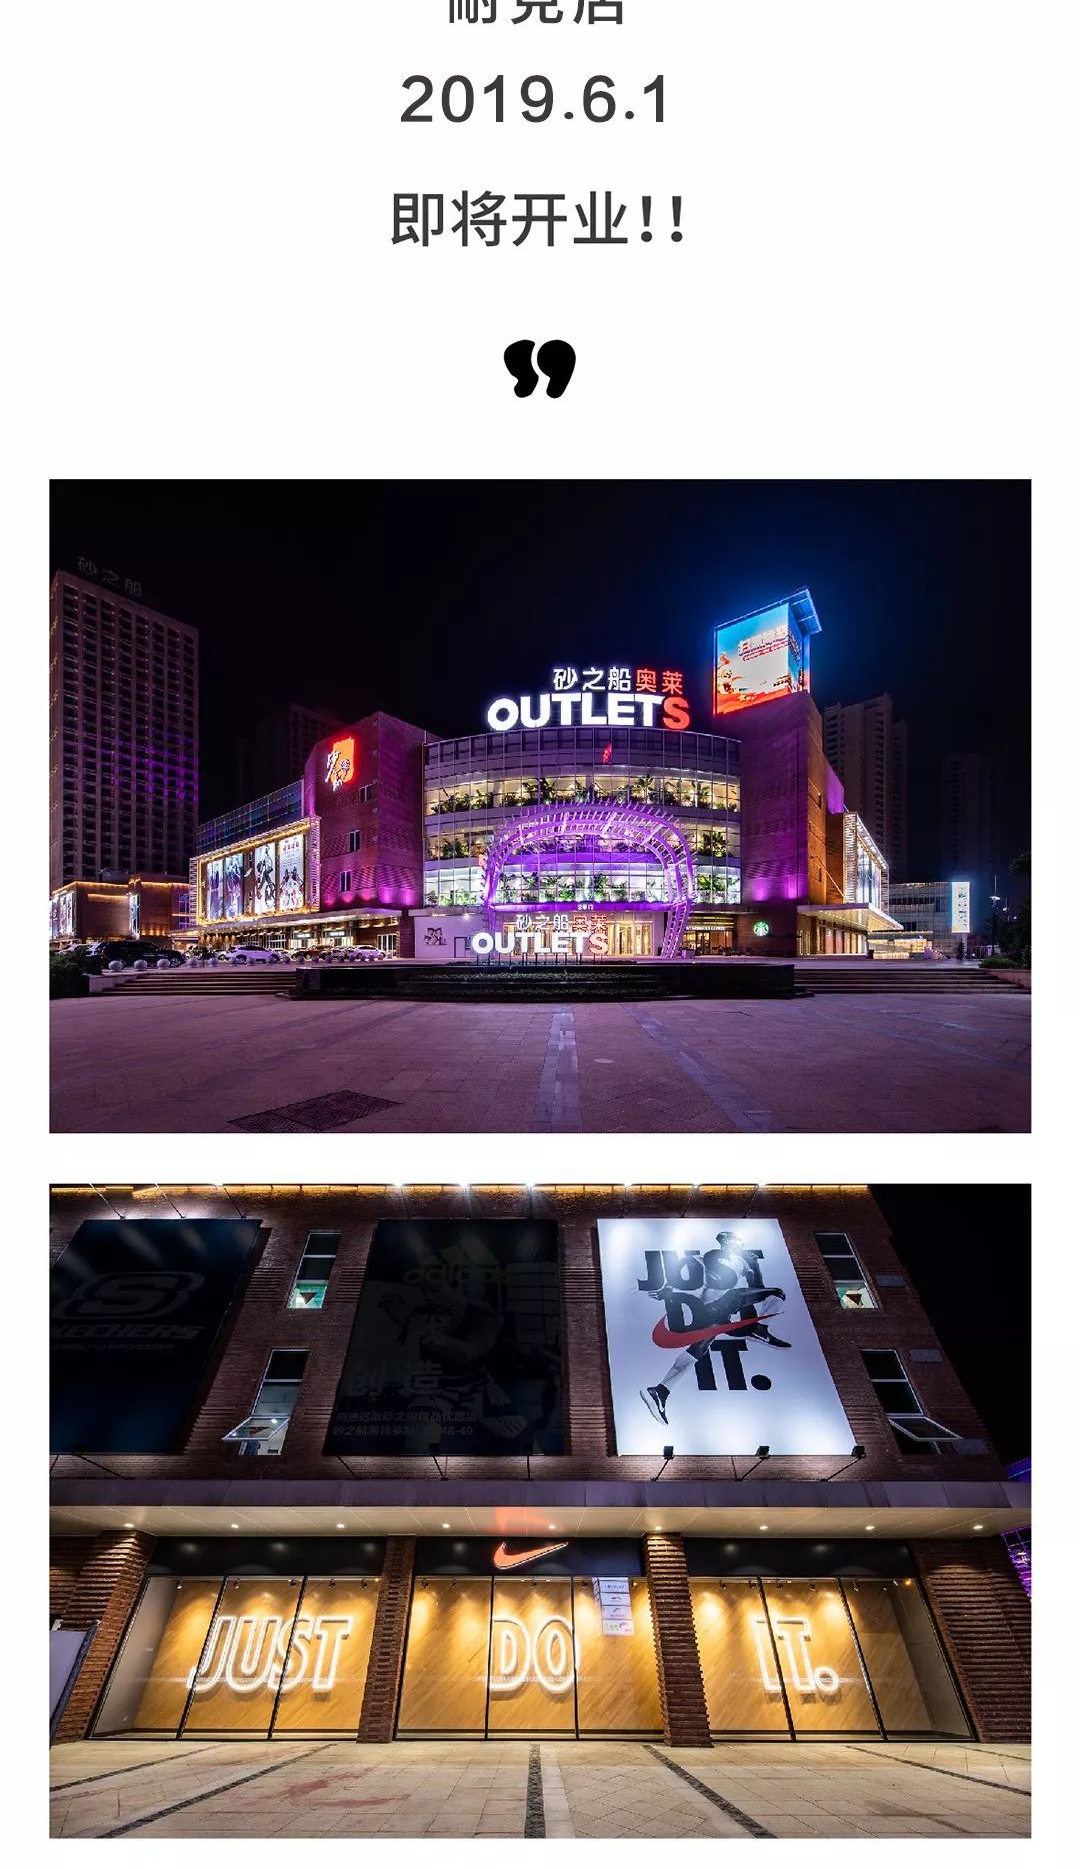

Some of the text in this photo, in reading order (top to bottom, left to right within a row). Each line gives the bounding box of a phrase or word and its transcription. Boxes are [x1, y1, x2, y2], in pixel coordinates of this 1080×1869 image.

[553, 667, 683, 695] 砂之船奥莱
[487, 692, 690, 731] OUTLETS
[472, 932, 609, 954] OUTLETS
[695, 1339, 773, 1391] IT.
[186, 1615, 838, 1694] JUST DO IT.
